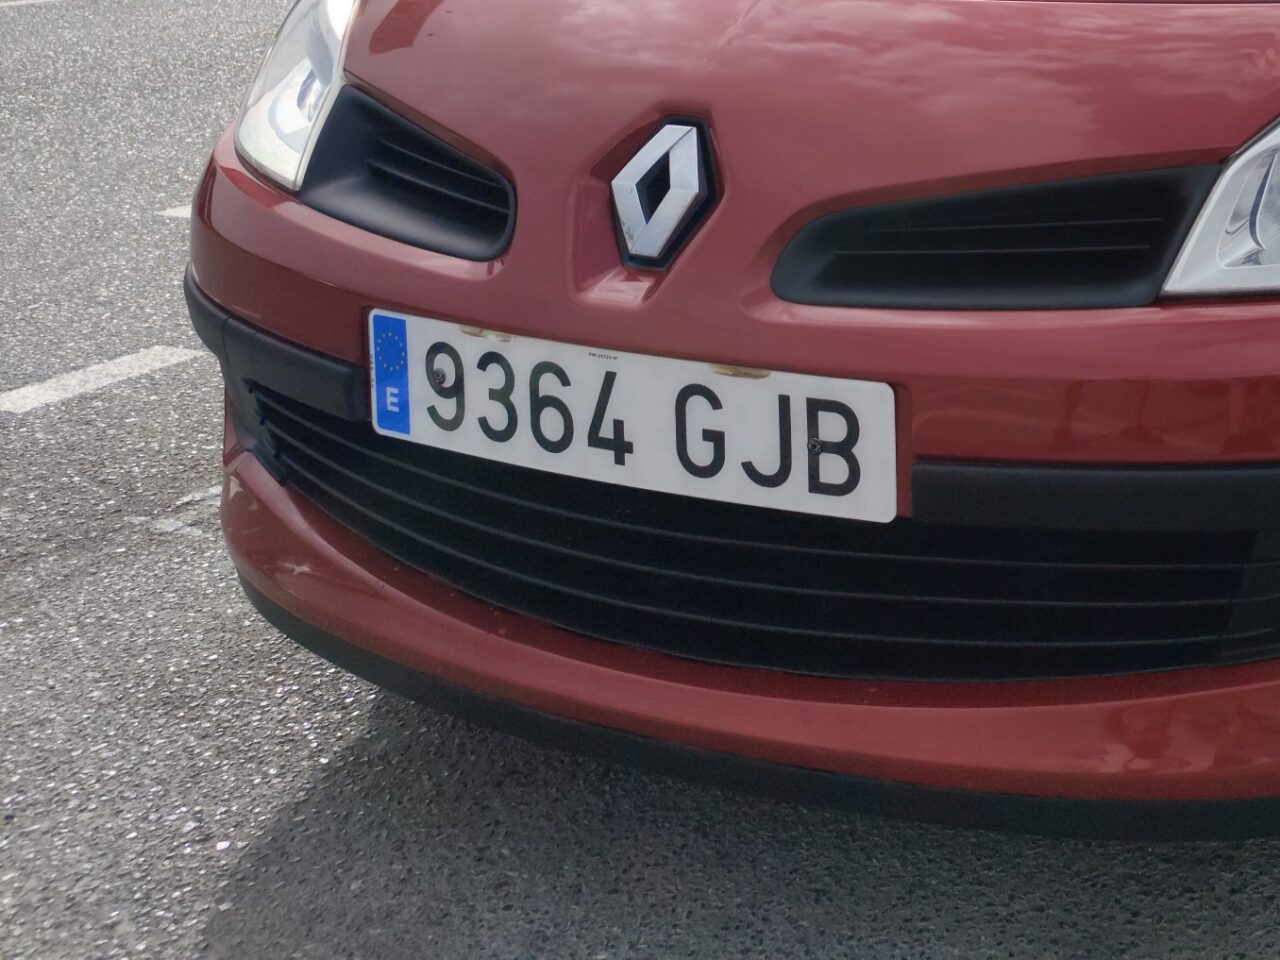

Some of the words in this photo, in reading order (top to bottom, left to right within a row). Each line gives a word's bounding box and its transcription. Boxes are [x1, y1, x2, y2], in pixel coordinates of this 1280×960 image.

[386, 386, 400, 413] E
[424, 340, 634, 467] 9364
[674, 382, 861, 497] GJB
